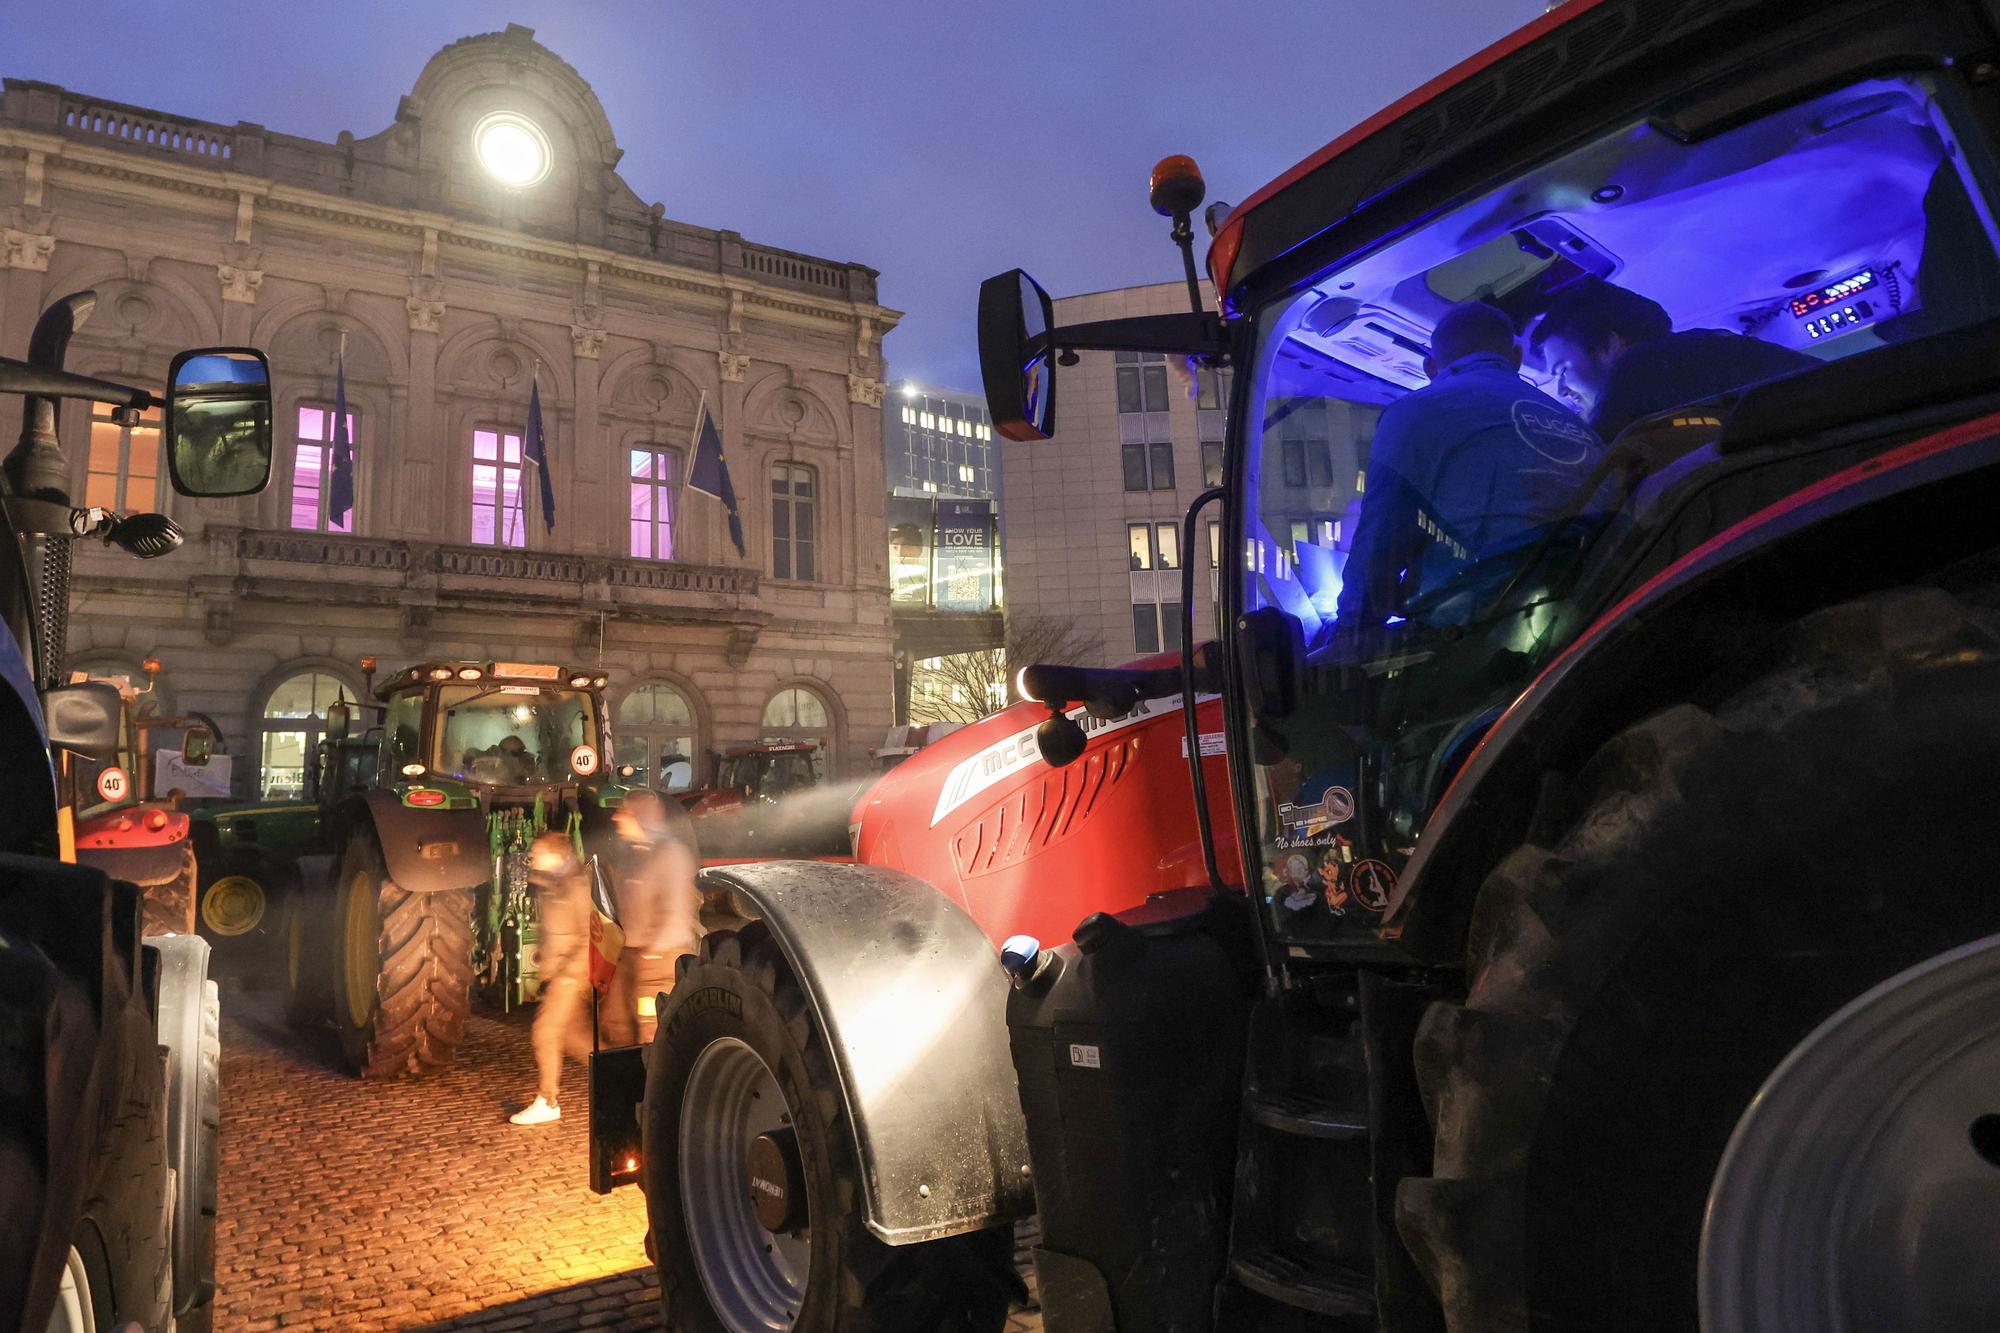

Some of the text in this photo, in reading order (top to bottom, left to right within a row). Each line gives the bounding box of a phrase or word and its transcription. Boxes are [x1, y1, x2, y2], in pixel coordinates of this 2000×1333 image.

[945, 534, 983, 546] LOVE
[576, 755, 589, 766] 40
[104, 778, 120, 790] 40
[1275, 833, 1337, 850] No shoes only
